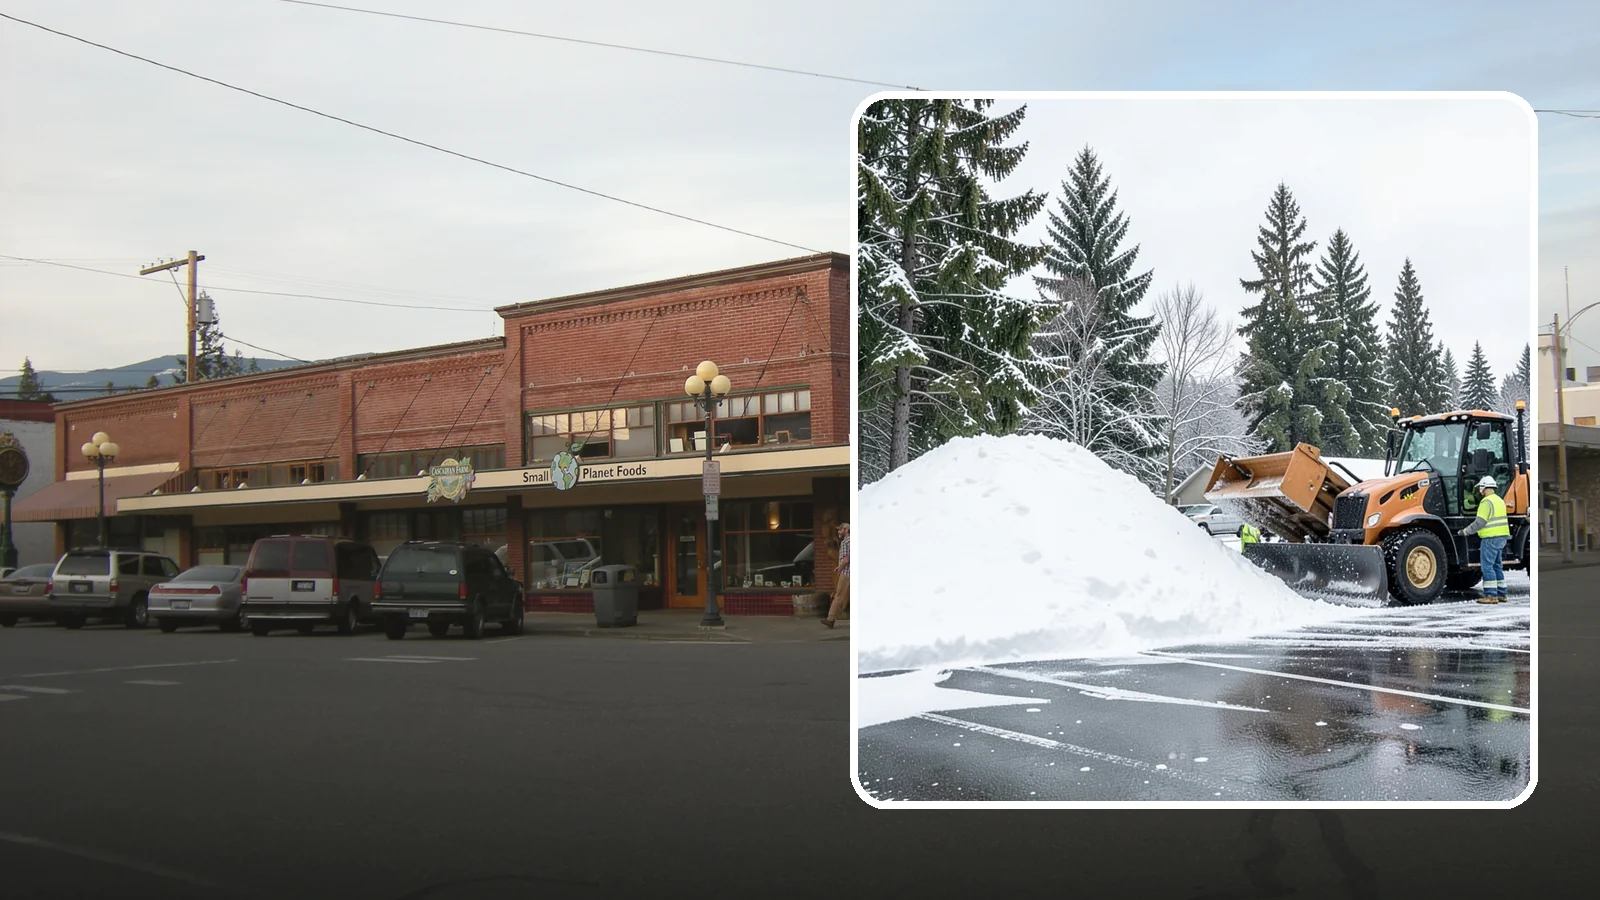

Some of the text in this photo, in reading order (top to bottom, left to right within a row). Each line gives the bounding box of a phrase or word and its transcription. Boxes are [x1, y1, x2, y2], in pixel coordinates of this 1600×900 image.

[523, 464, 647, 483] Small Planet Foods
